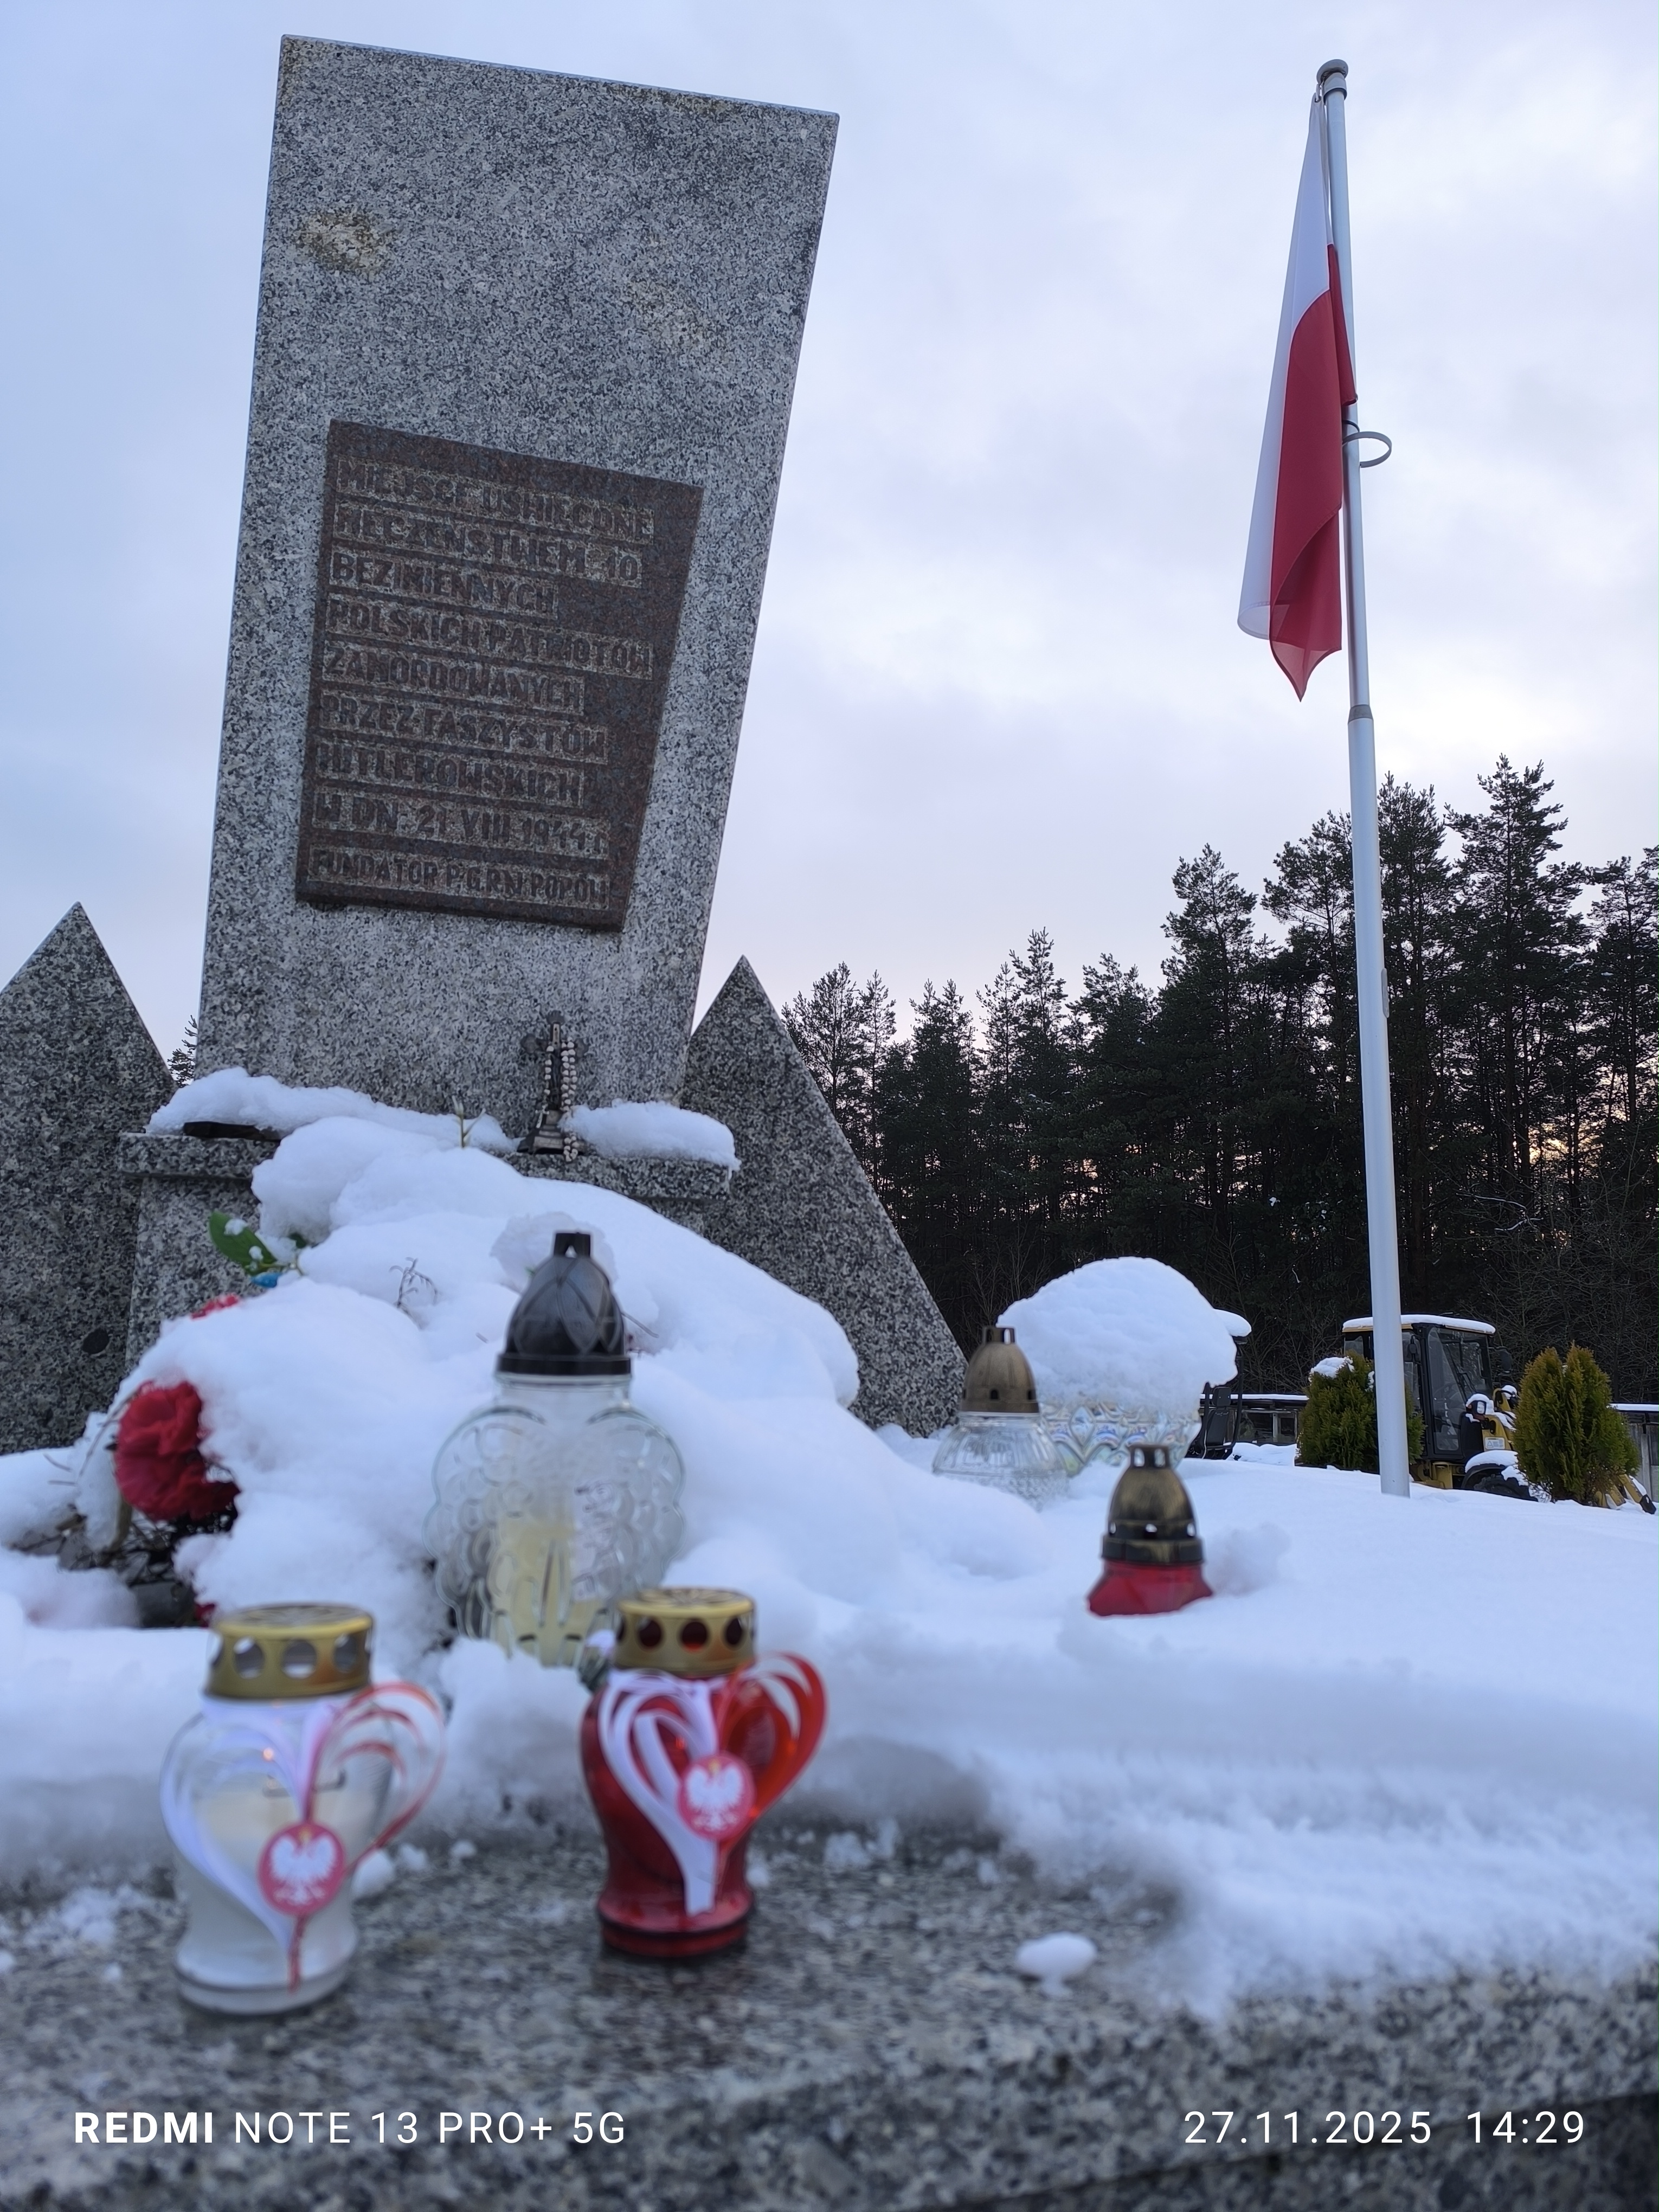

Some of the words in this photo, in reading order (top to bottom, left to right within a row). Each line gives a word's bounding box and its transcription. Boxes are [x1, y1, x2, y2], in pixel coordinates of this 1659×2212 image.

[607, 552, 641, 581] 10
[328, 599, 482, 647] POLSKICH
[325, 646, 583, 709] ZAMORDOWANYCH
[320, 695, 414, 734] PRZEZ
[318, 742, 582, 802] HITLEROWSKICH
[315, 792, 342, 821] W
[415, 803, 449, 834] 21
[520, 816, 588, 851] 1944
[311, 848, 439, 886] FUNDATOR
